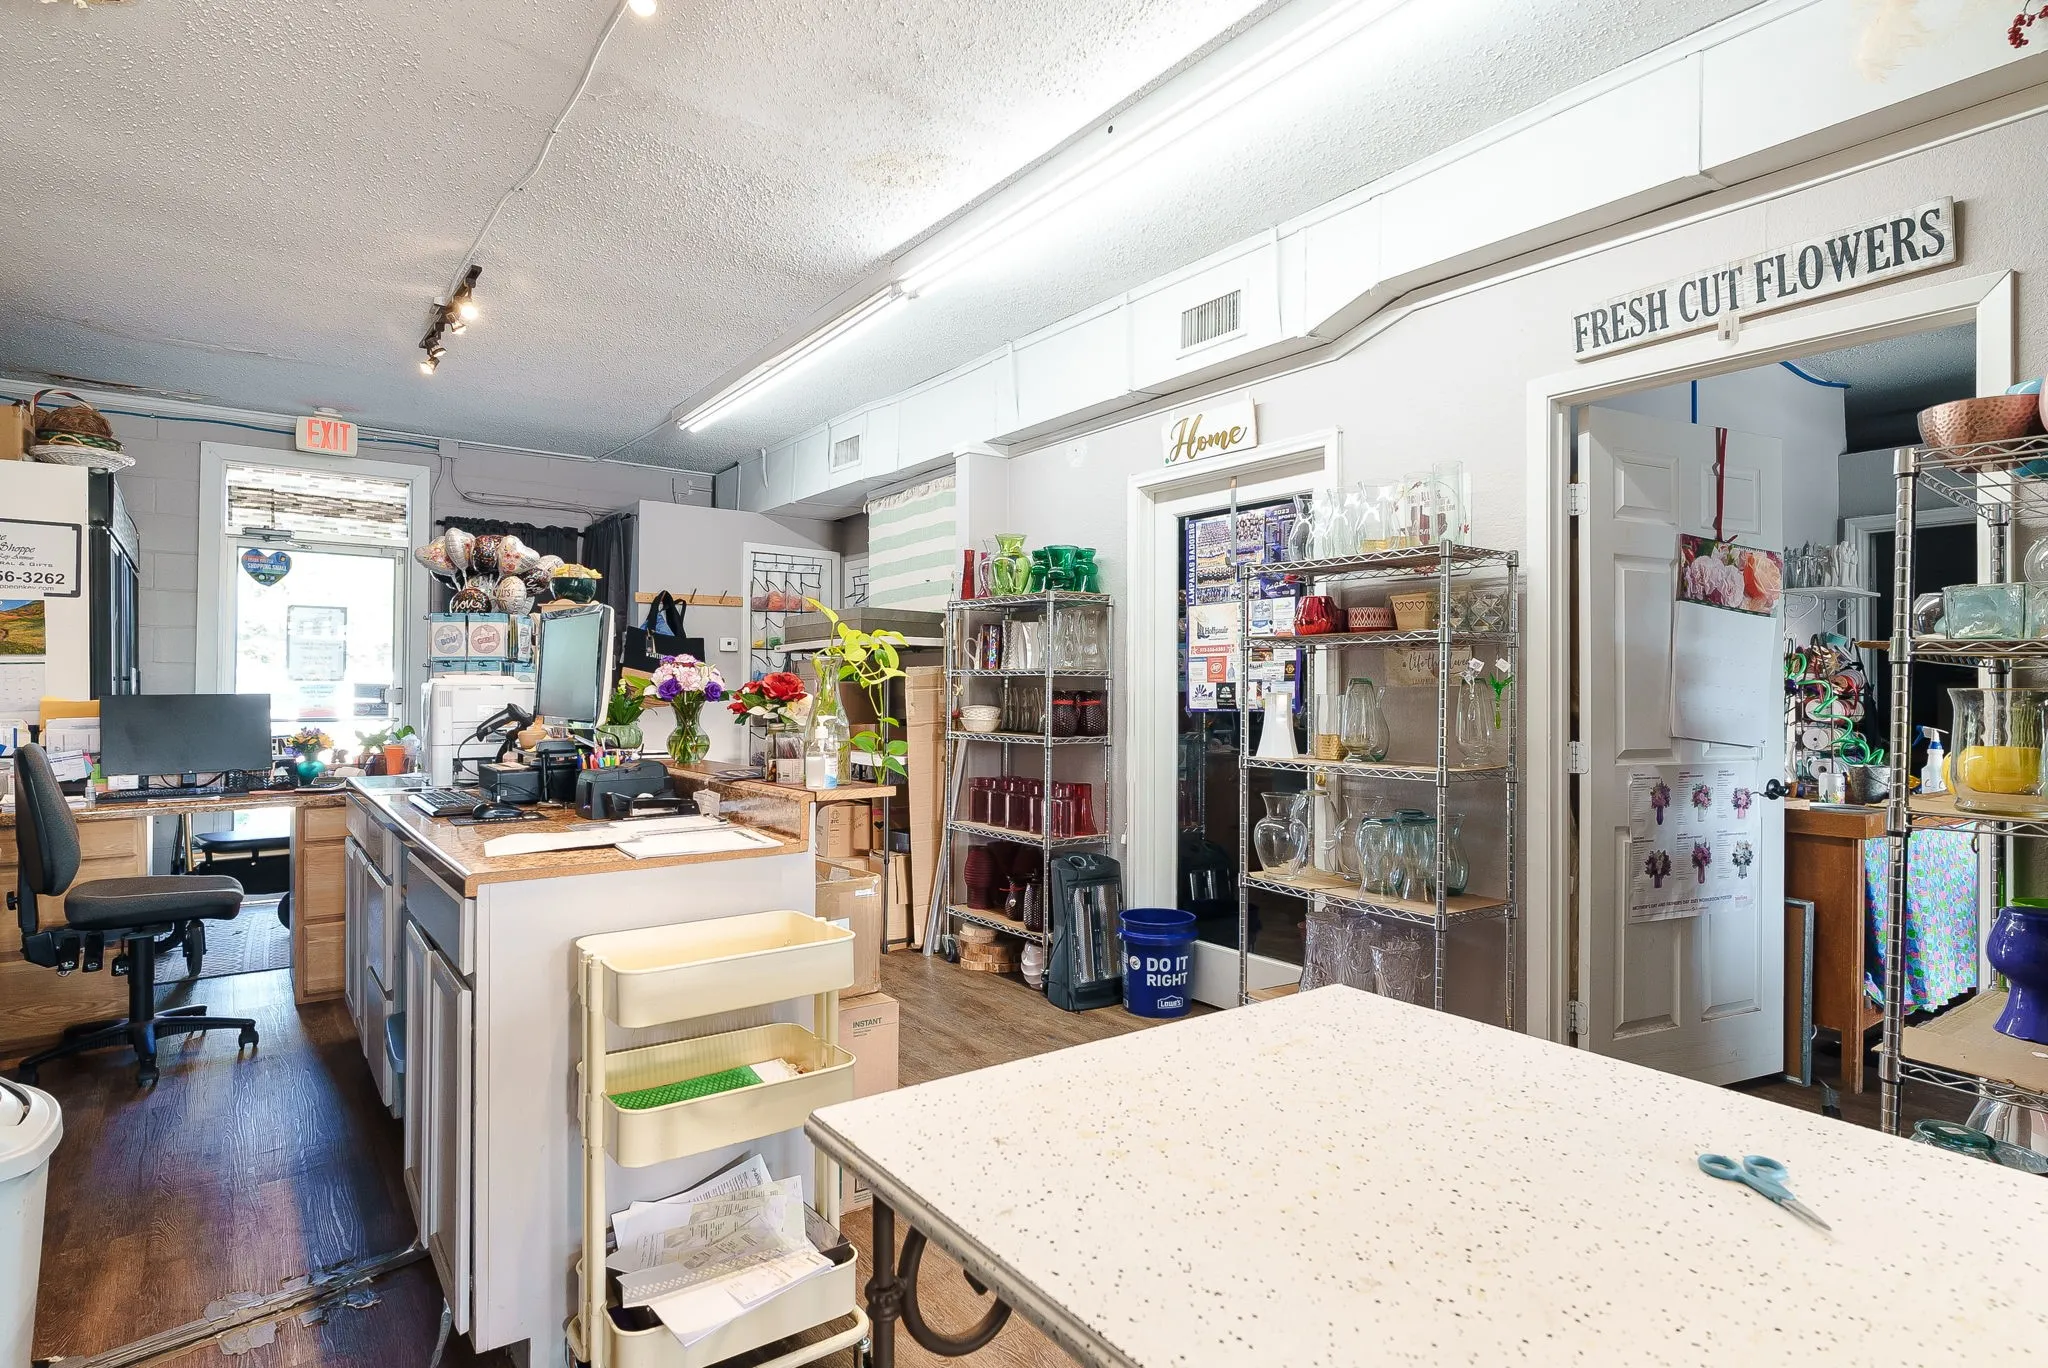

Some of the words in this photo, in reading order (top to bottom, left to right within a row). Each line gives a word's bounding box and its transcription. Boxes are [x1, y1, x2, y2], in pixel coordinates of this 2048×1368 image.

[1573, 289, 1669, 353] FRESH
[1679, 266, 1743, 323] CUT
[1754, 208, 1945, 304] FLOWERS
[307, 418, 350, 452] EXIT
[1170, 413, 1247, 462] Home
[0, 541, 36, 555] Shoppe
[1409, 652, 1425, 673] life
[1146, 957, 1171, 972] DO
[1176, 956, 1189, 971] IT
[1146, 972, 1188, 987] RIGHT
[853, 1017, 882, 1028] INSTANT
